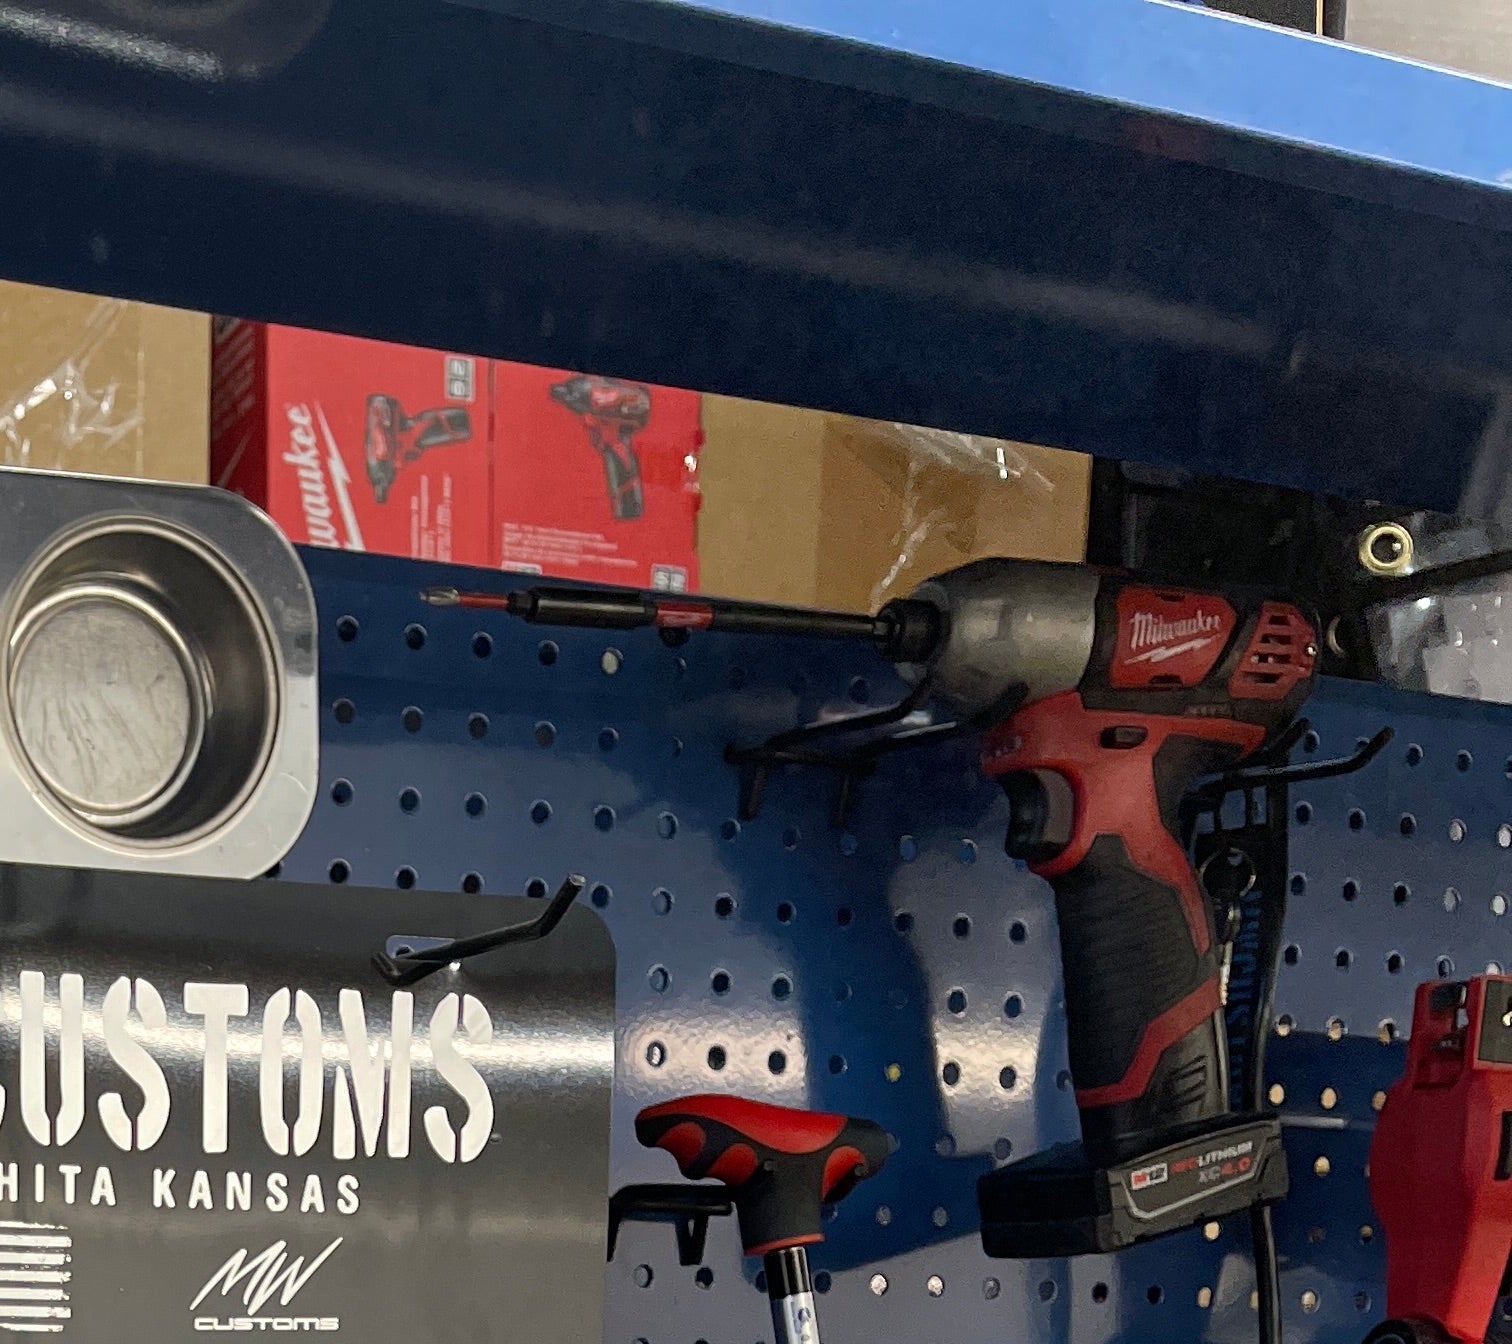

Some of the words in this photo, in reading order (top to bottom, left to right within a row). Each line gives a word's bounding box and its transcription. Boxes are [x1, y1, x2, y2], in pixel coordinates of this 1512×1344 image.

[283, 401, 339, 549] waukee
[1129, 609, 1222, 651] Milwaukee
[152, 1167, 361, 1215] KANSAS
[189, 1236, 344, 1316] MW
[193, 1316, 340, 1332] CUSTOMS
